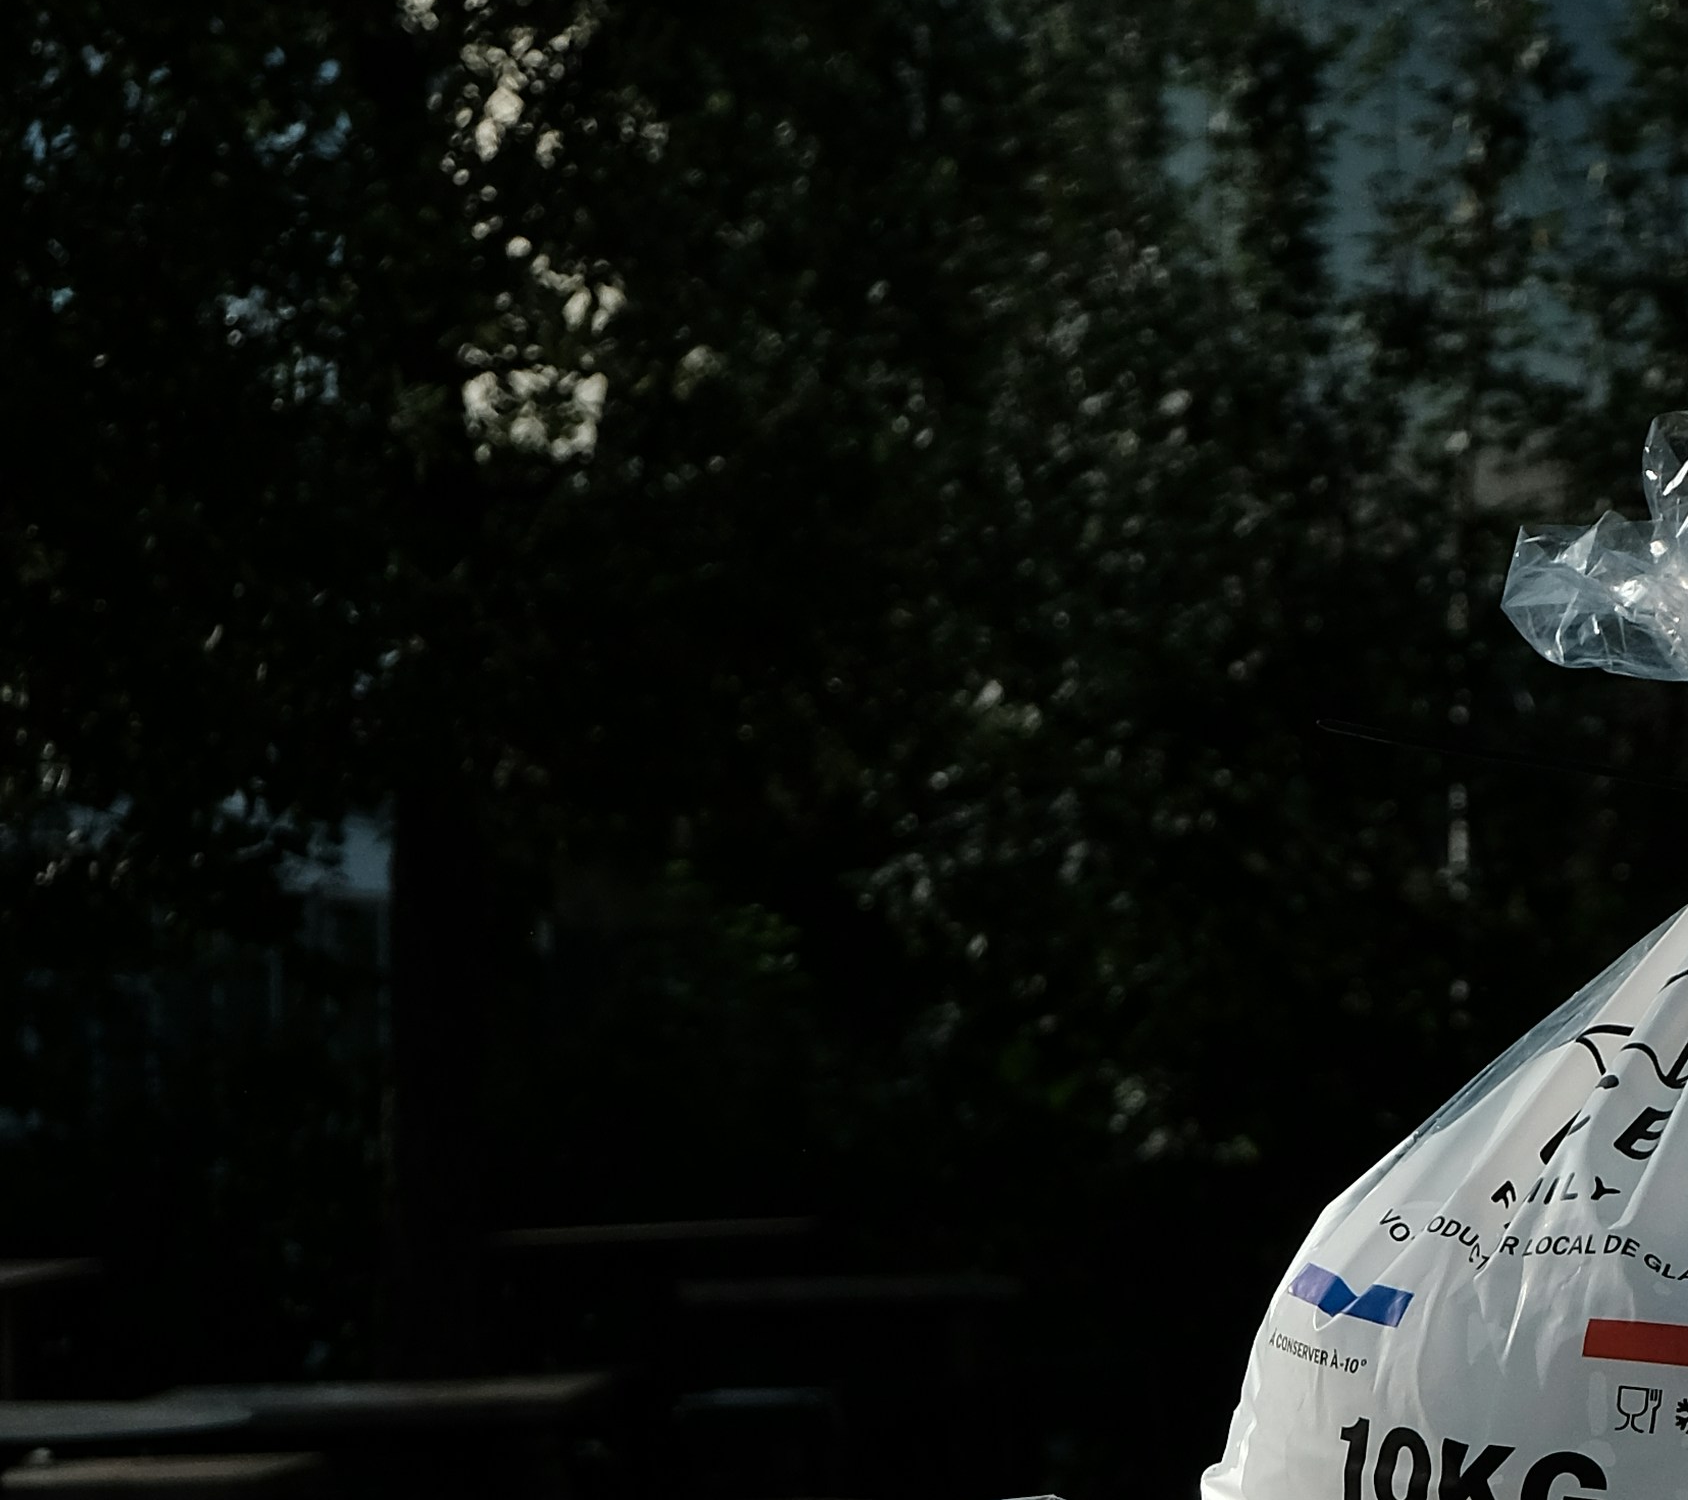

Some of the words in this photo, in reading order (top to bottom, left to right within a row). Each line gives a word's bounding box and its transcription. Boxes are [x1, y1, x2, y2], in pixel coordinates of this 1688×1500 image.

[1522, 1235, 1596, 1257] LOCAL
[1602, 1234, 1640, 1258] DE
[1275, 1333, 1329, 1366] CONSERVER
